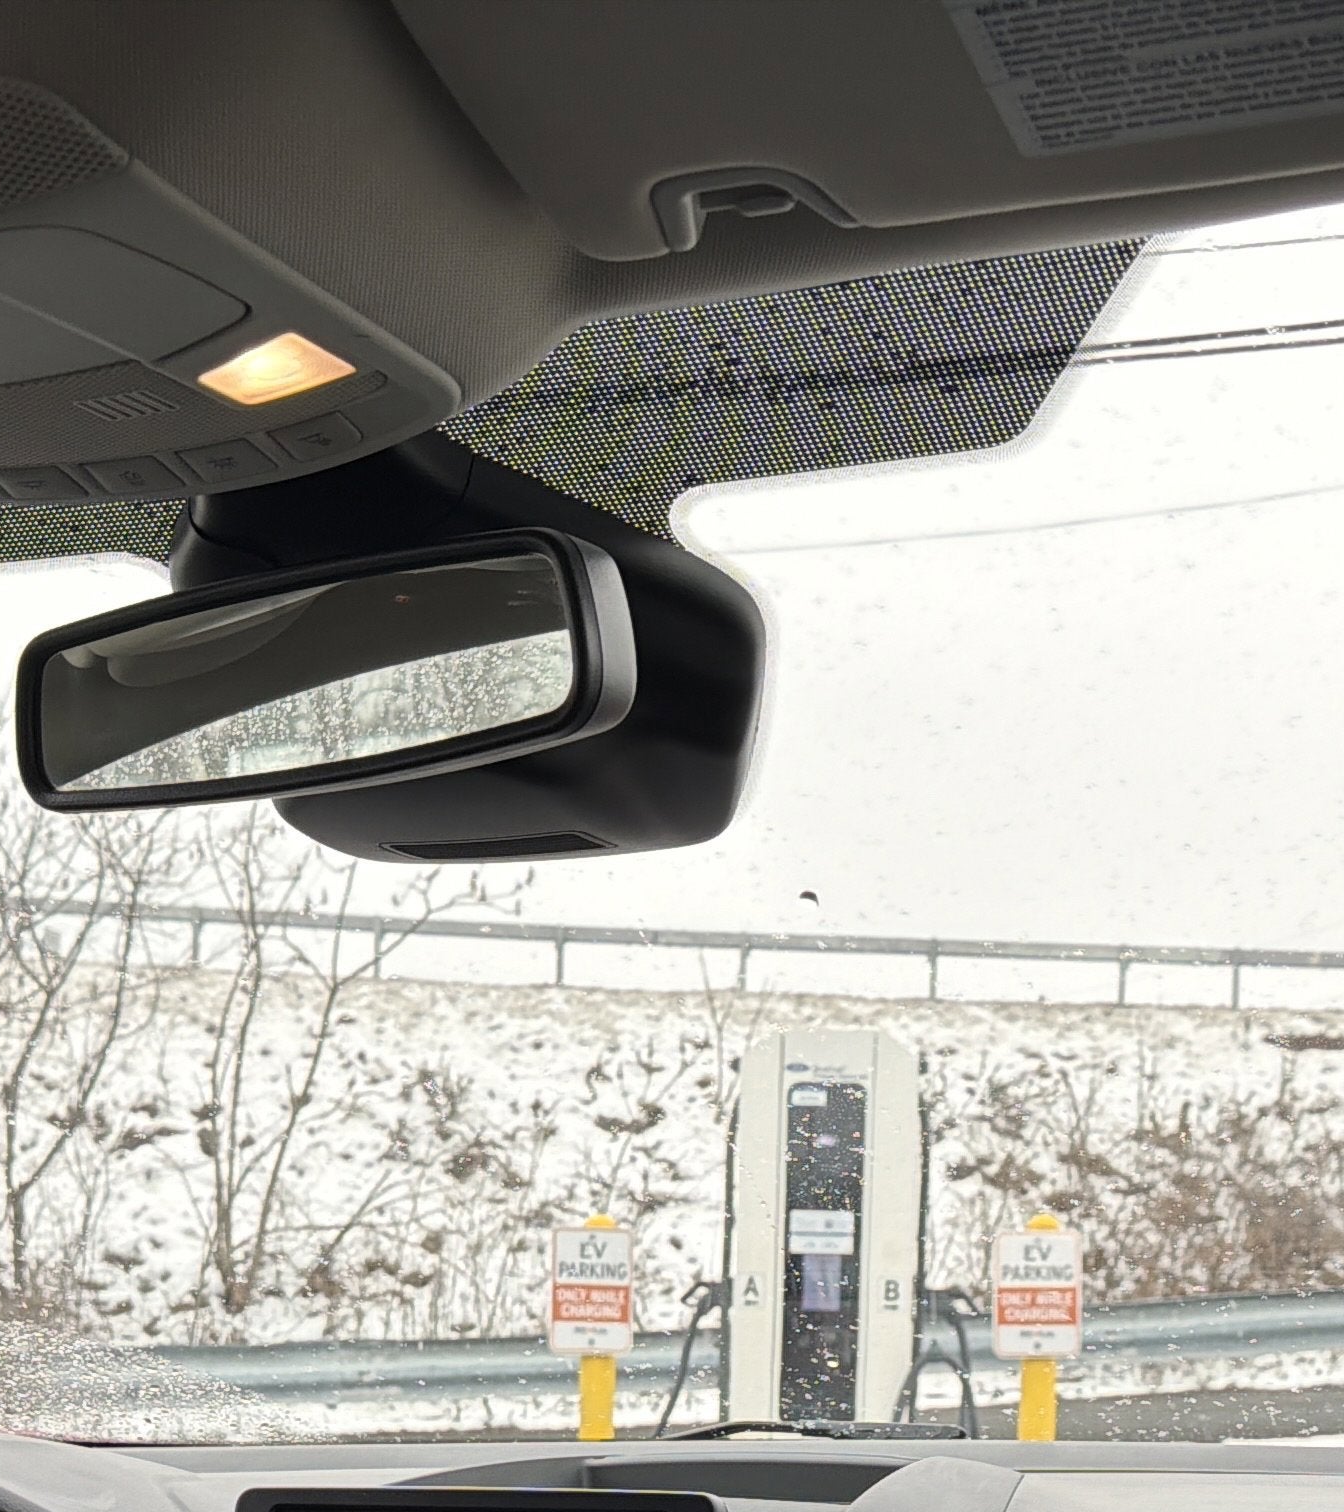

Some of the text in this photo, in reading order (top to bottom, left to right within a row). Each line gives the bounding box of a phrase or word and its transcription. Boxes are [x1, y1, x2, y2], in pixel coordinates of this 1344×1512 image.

[580, 1242, 607, 1259] EV
[1023, 1245, 1052, 1262] EV
[559, 1261, 628, 1281] PARKING
[1002, 1264, 1074, 1281] PARKING
[744, 1275, 759, 1298] A
[884, 1279, 900, 1301] B
